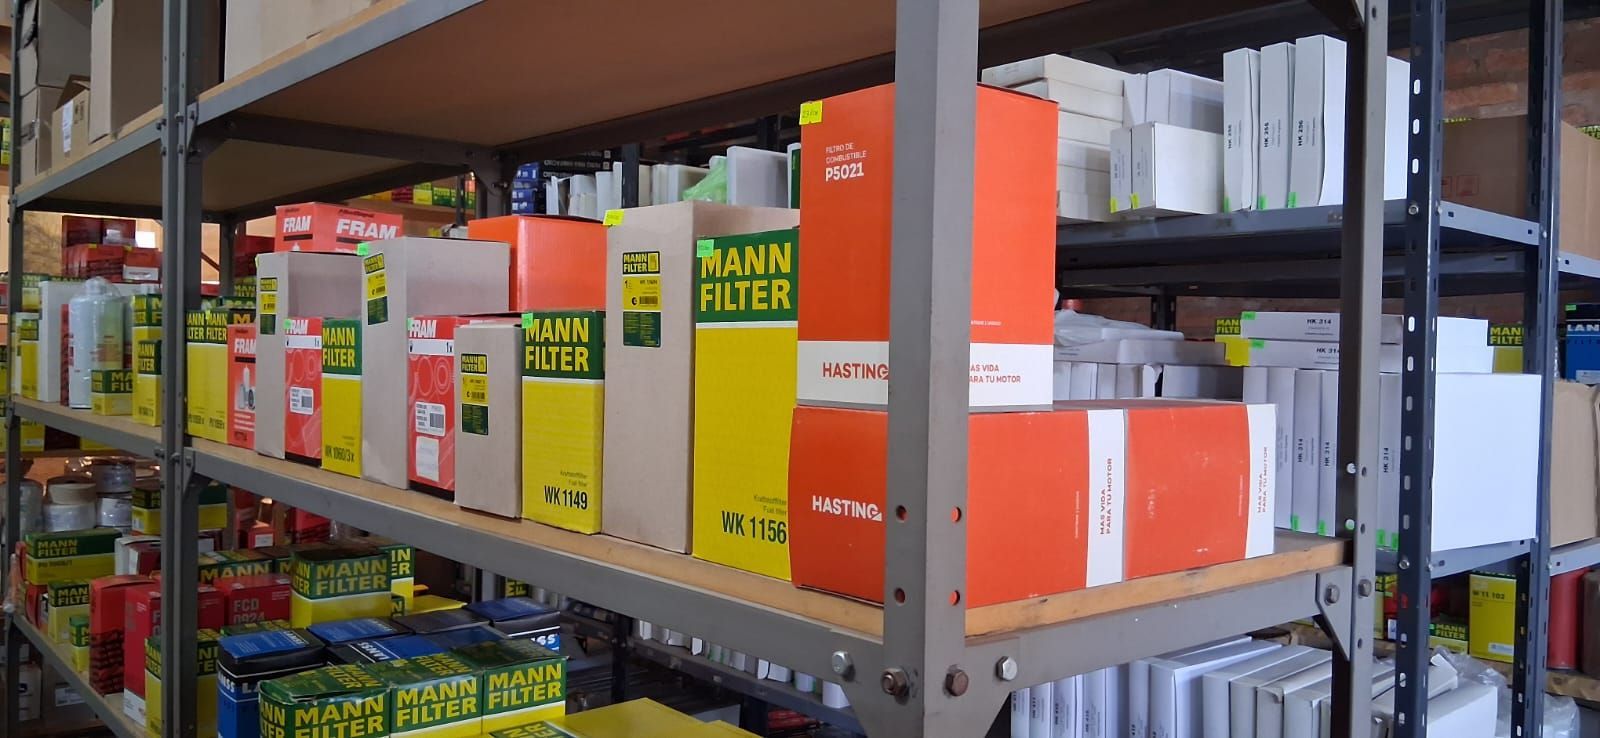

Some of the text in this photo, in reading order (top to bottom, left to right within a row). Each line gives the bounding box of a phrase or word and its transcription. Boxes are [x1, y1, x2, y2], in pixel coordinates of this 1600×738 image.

[825, 142, 854, 154] FILTRO DE
[825, 150, 867, 164] COMBUSTIBLE
[825, 162, 865, 182] P5021
[283, 215, 312, 233] FRAM
[336, 218, 398, 240] FRAM
[624, 253, 648, 263] MANN
[701, 242, 791, 278] MANN
[623, 263, 648, 273] FILTER
[700, 279, 791, 311] FILTER
[186, 312, 205, 326] ANN
[186, 327, 205, 341] LTER
[206, 327, 227, 341] FILTER
[525, 317, 589, 343] MANN
[1216, 326, 1240, 334] FILTE
[1567, 324, 1600, 332] LAN
[323, 327, 355, 346] MANN
[1490, 336, 1522, 344] FILTE
[323, 347, 356, 368] FILTER
[525, 345, 589, 372] FILTER
[461, 364, 478, 372] FILTER
[822, 361, 889, 381] HASTING
[112, 372, 132, 381] MA
[969, 375, 1021, 384] ARA TU MOTOR
[112, 382, 132, 392] FIL
[544, 484, 588, 511] WK 1149
[1107, 493, 1112, 505] TU
[812, 495, 882, 521] HASTING
[721, 510, 787, 545] WK 1156
[38, 540, 77, 549] MANN
[38, 547, 77, 557] FILTER
[316, 558, 387, 580] MANN
[58, 587, 89, 597] MAN
[316, 574, 387, 596] FILTER
[58, 596, 89, 605] FILTE
[233, 597, 260, 613] FCD
[1435, 623, 1466, 632] MANN
[1435, 630, 1466, 640] FILTER
[489, 664, 562, 692] MANN
[397, 677, 477, 708] MANN
[488, 681, 562, 710] FILTER
[295, 695, 384, 727] MANN
[396, 697, 477, 728] FILTER
